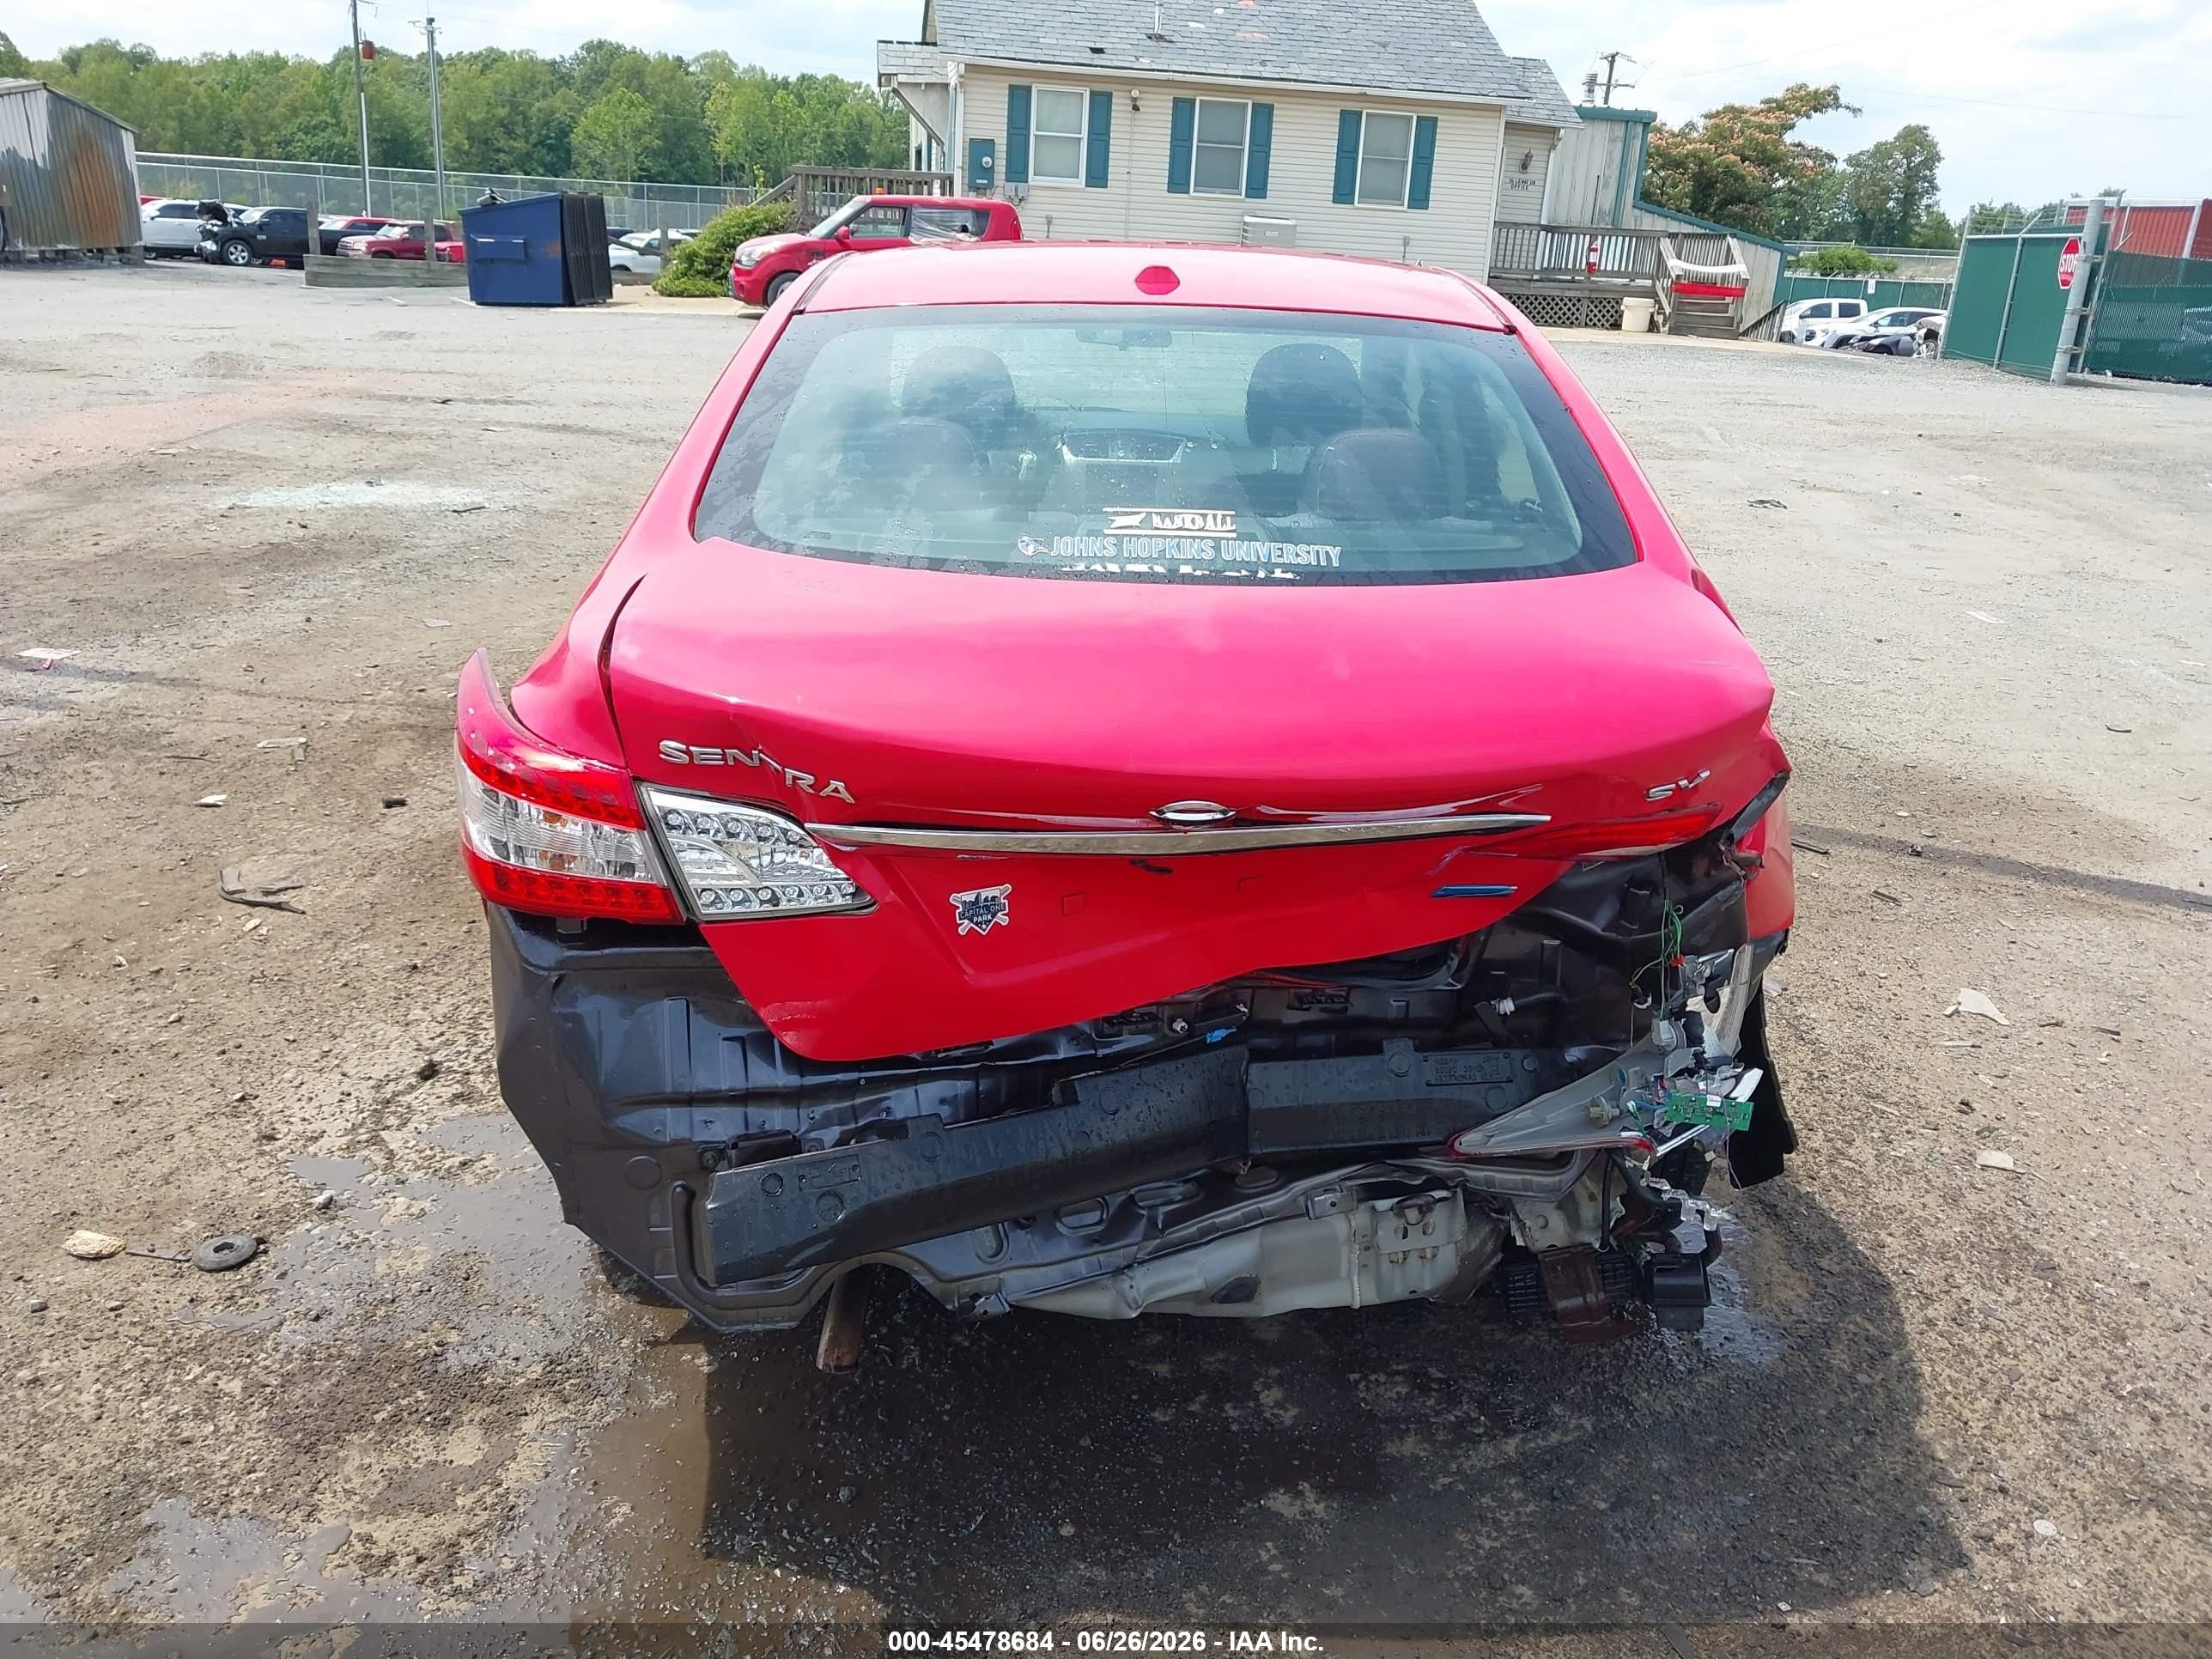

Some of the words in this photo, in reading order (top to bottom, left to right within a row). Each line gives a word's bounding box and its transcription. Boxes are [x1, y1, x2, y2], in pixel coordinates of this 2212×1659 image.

[1050, 536, 1117, 556] JOHNS
[1123, 537, 1215, 561] HOPKINS
[1220, 539, 1341, 567] UNIVERSITY
[659, 739, 855, 804] SENTRA
[960, 907, 988, 918] CAPITAL
[990, 902, 1005, 912] ONE
[974, 914, 992, 922] PARK
